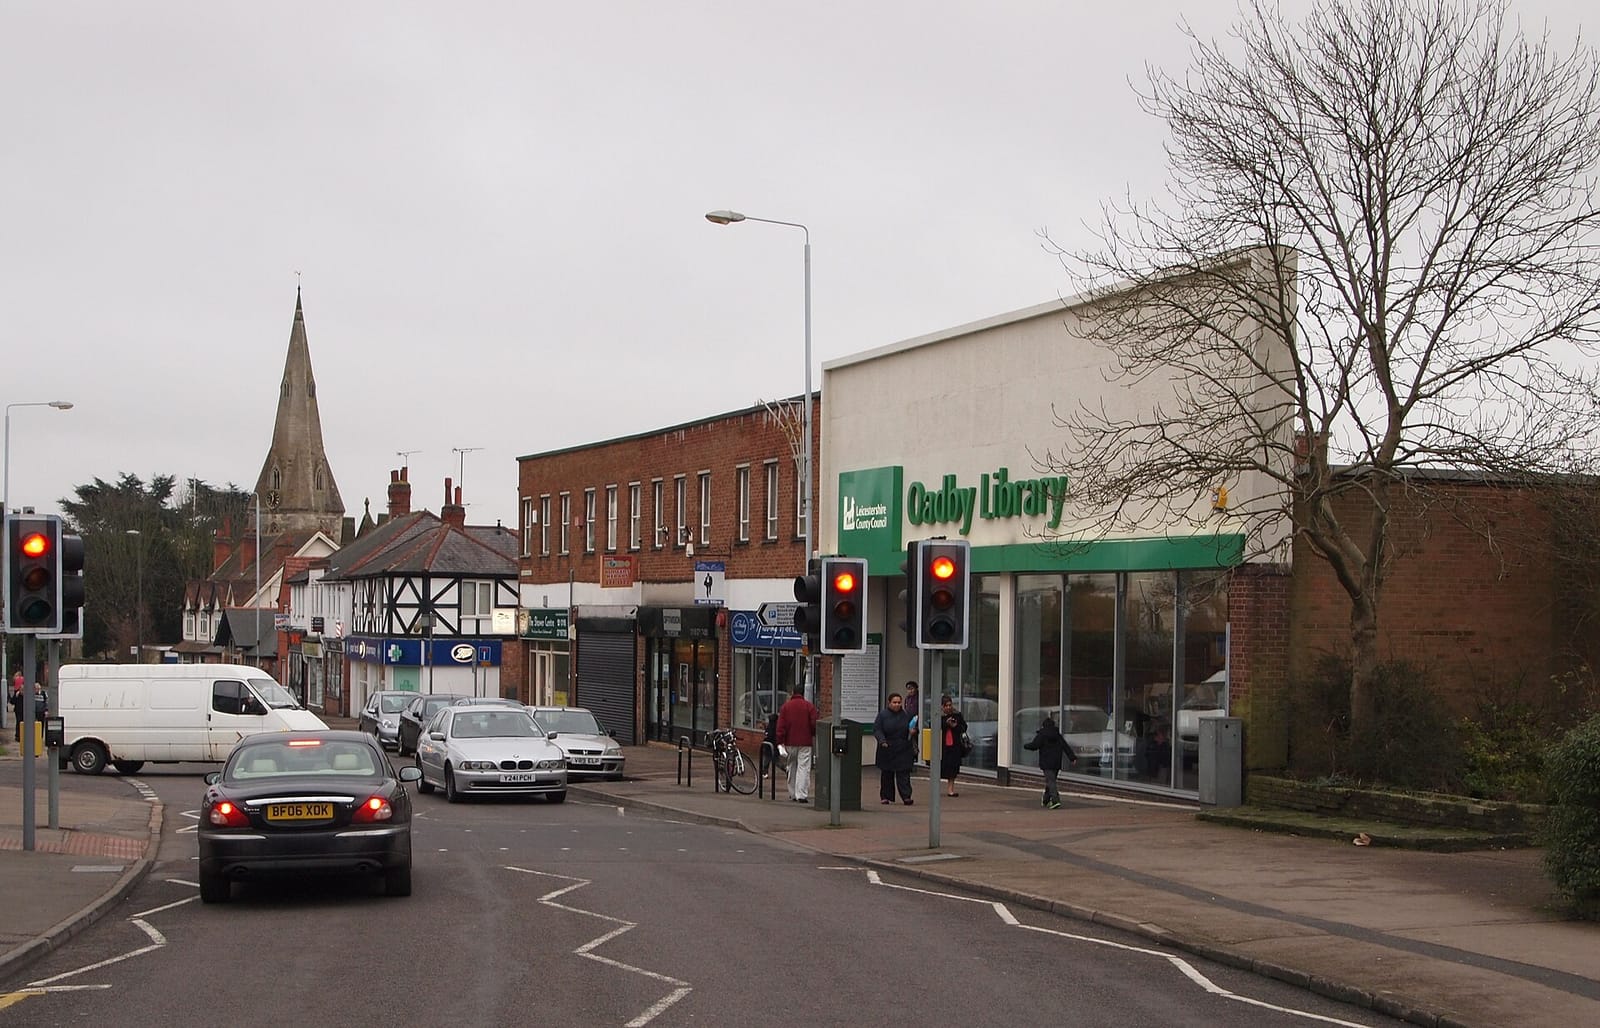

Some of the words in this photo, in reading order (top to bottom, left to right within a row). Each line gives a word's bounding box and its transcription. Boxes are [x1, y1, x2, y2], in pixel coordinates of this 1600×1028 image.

[907, 474, 977, 536] Oadby
[979, 467, 1068, 529] Library
[856, 503, 887, 517] Leicestershire
[856, 518, 871, 531] County
[870, 516, 887, 529] Council
[519, 774, 532, 782] PCH
[272, 806, 303, 817] BF06
[306, 804, 329, 816] XOK
